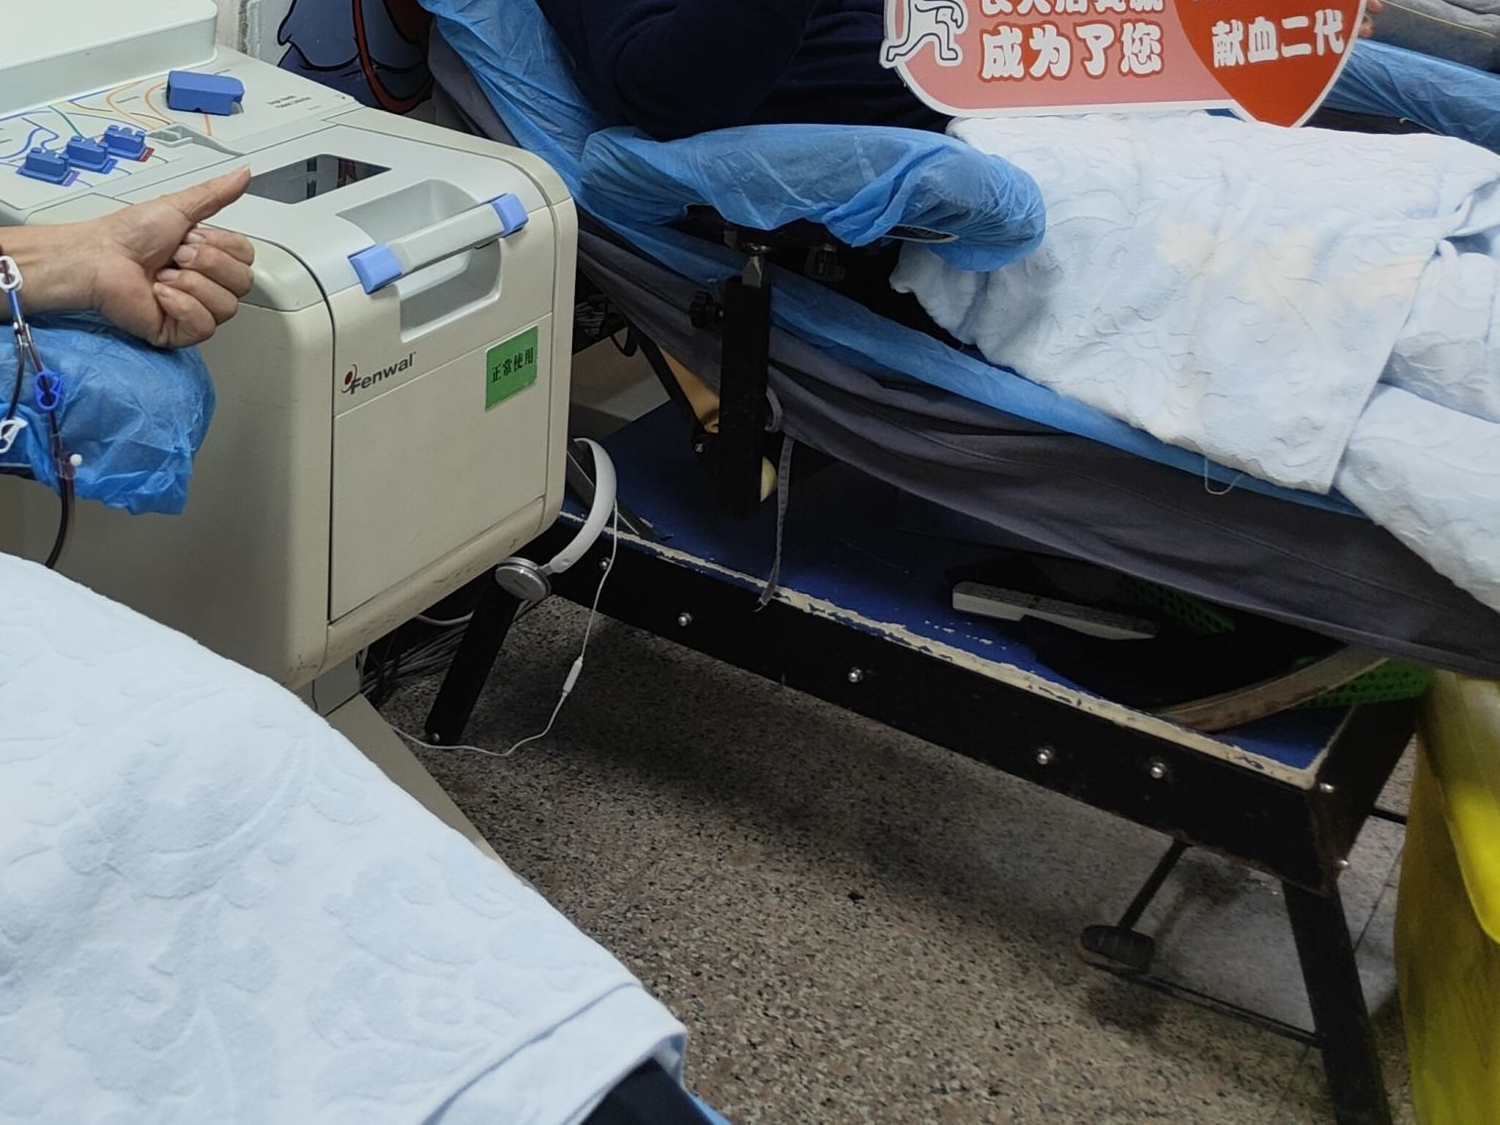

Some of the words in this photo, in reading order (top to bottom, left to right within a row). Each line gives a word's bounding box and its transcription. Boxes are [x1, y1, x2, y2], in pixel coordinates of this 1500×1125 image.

[981, 20, 1163, 80] 成为了您
[1211, 8, 1345, 69] 献血二代
[491, 346, 534, 384] 正常使用
